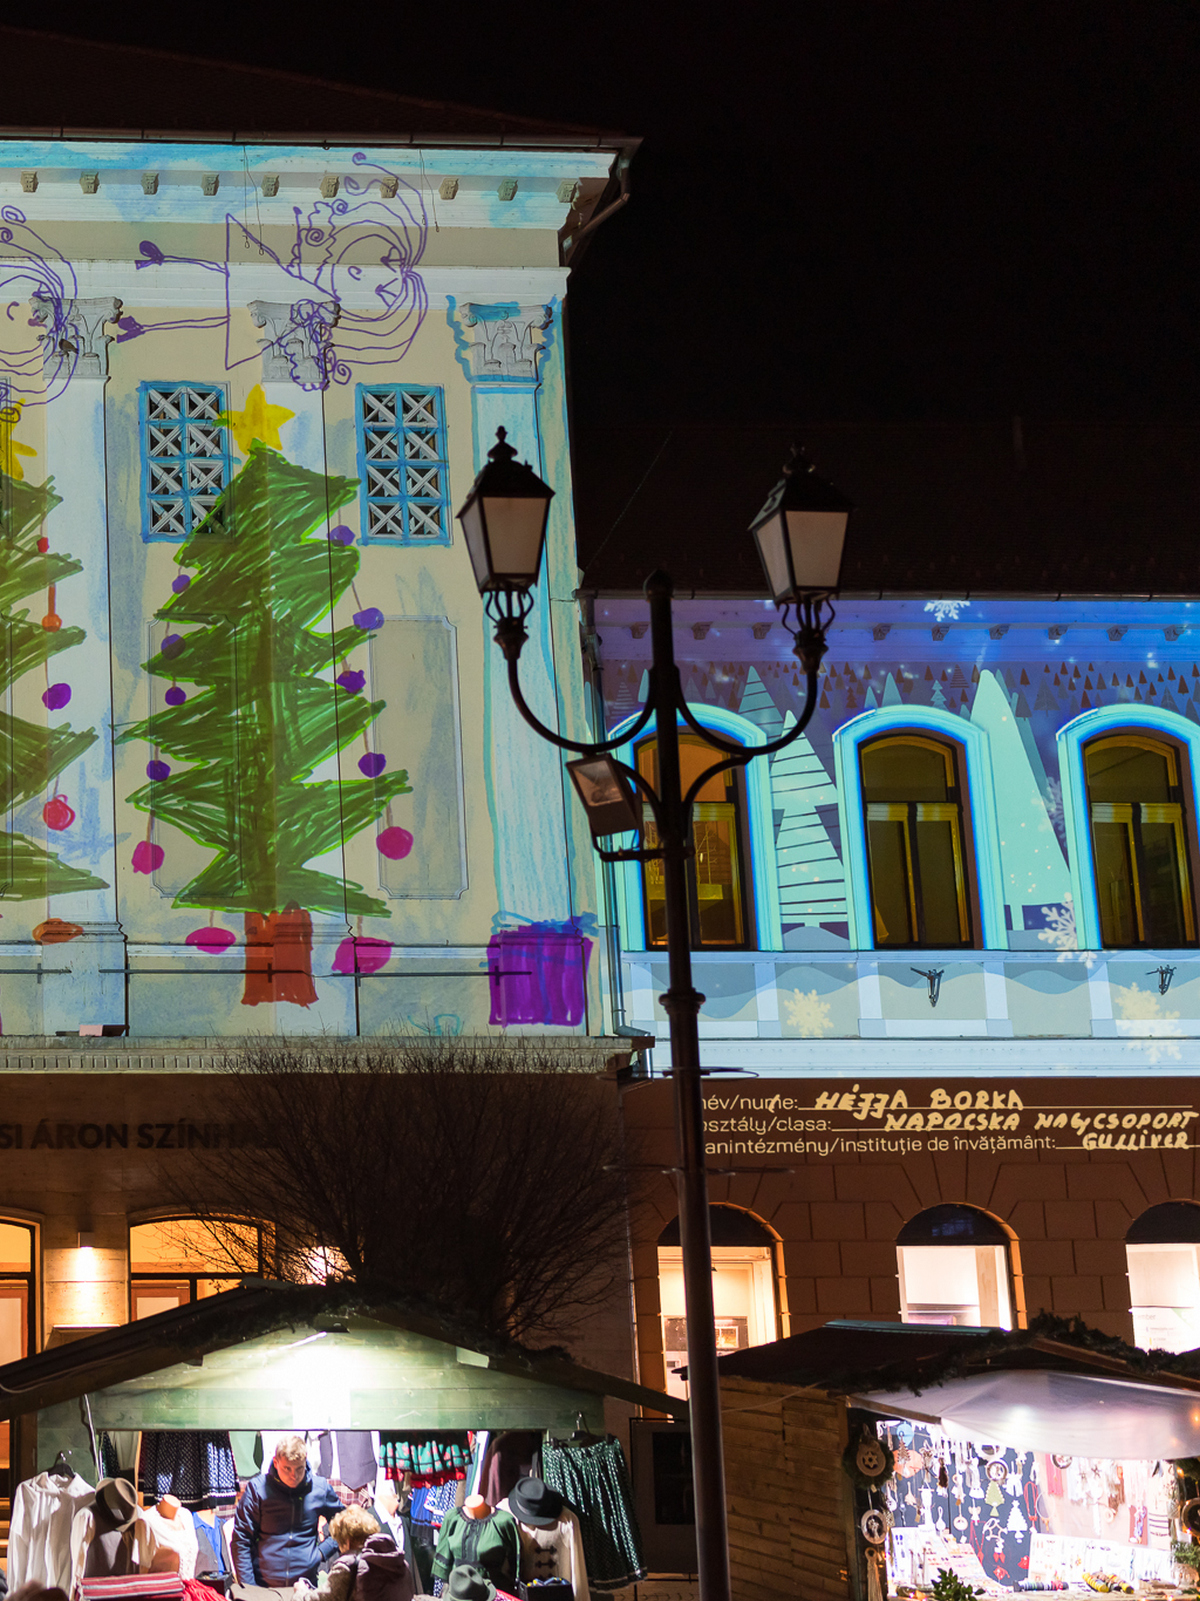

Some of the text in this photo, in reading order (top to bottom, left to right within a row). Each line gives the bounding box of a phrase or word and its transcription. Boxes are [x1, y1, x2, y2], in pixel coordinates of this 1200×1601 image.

[930, 1088, 1024, 1112] BORKA
[884, 1111, 1021, 1132] NAPOCSKA
[30, 1117, 129, 1150] ÁRON
[704, 1137, 923, 1157] anintézmény/instituție
[927, 1136, 949, 1152] de
[953, 1134, 1057, 1155] învățământ:
